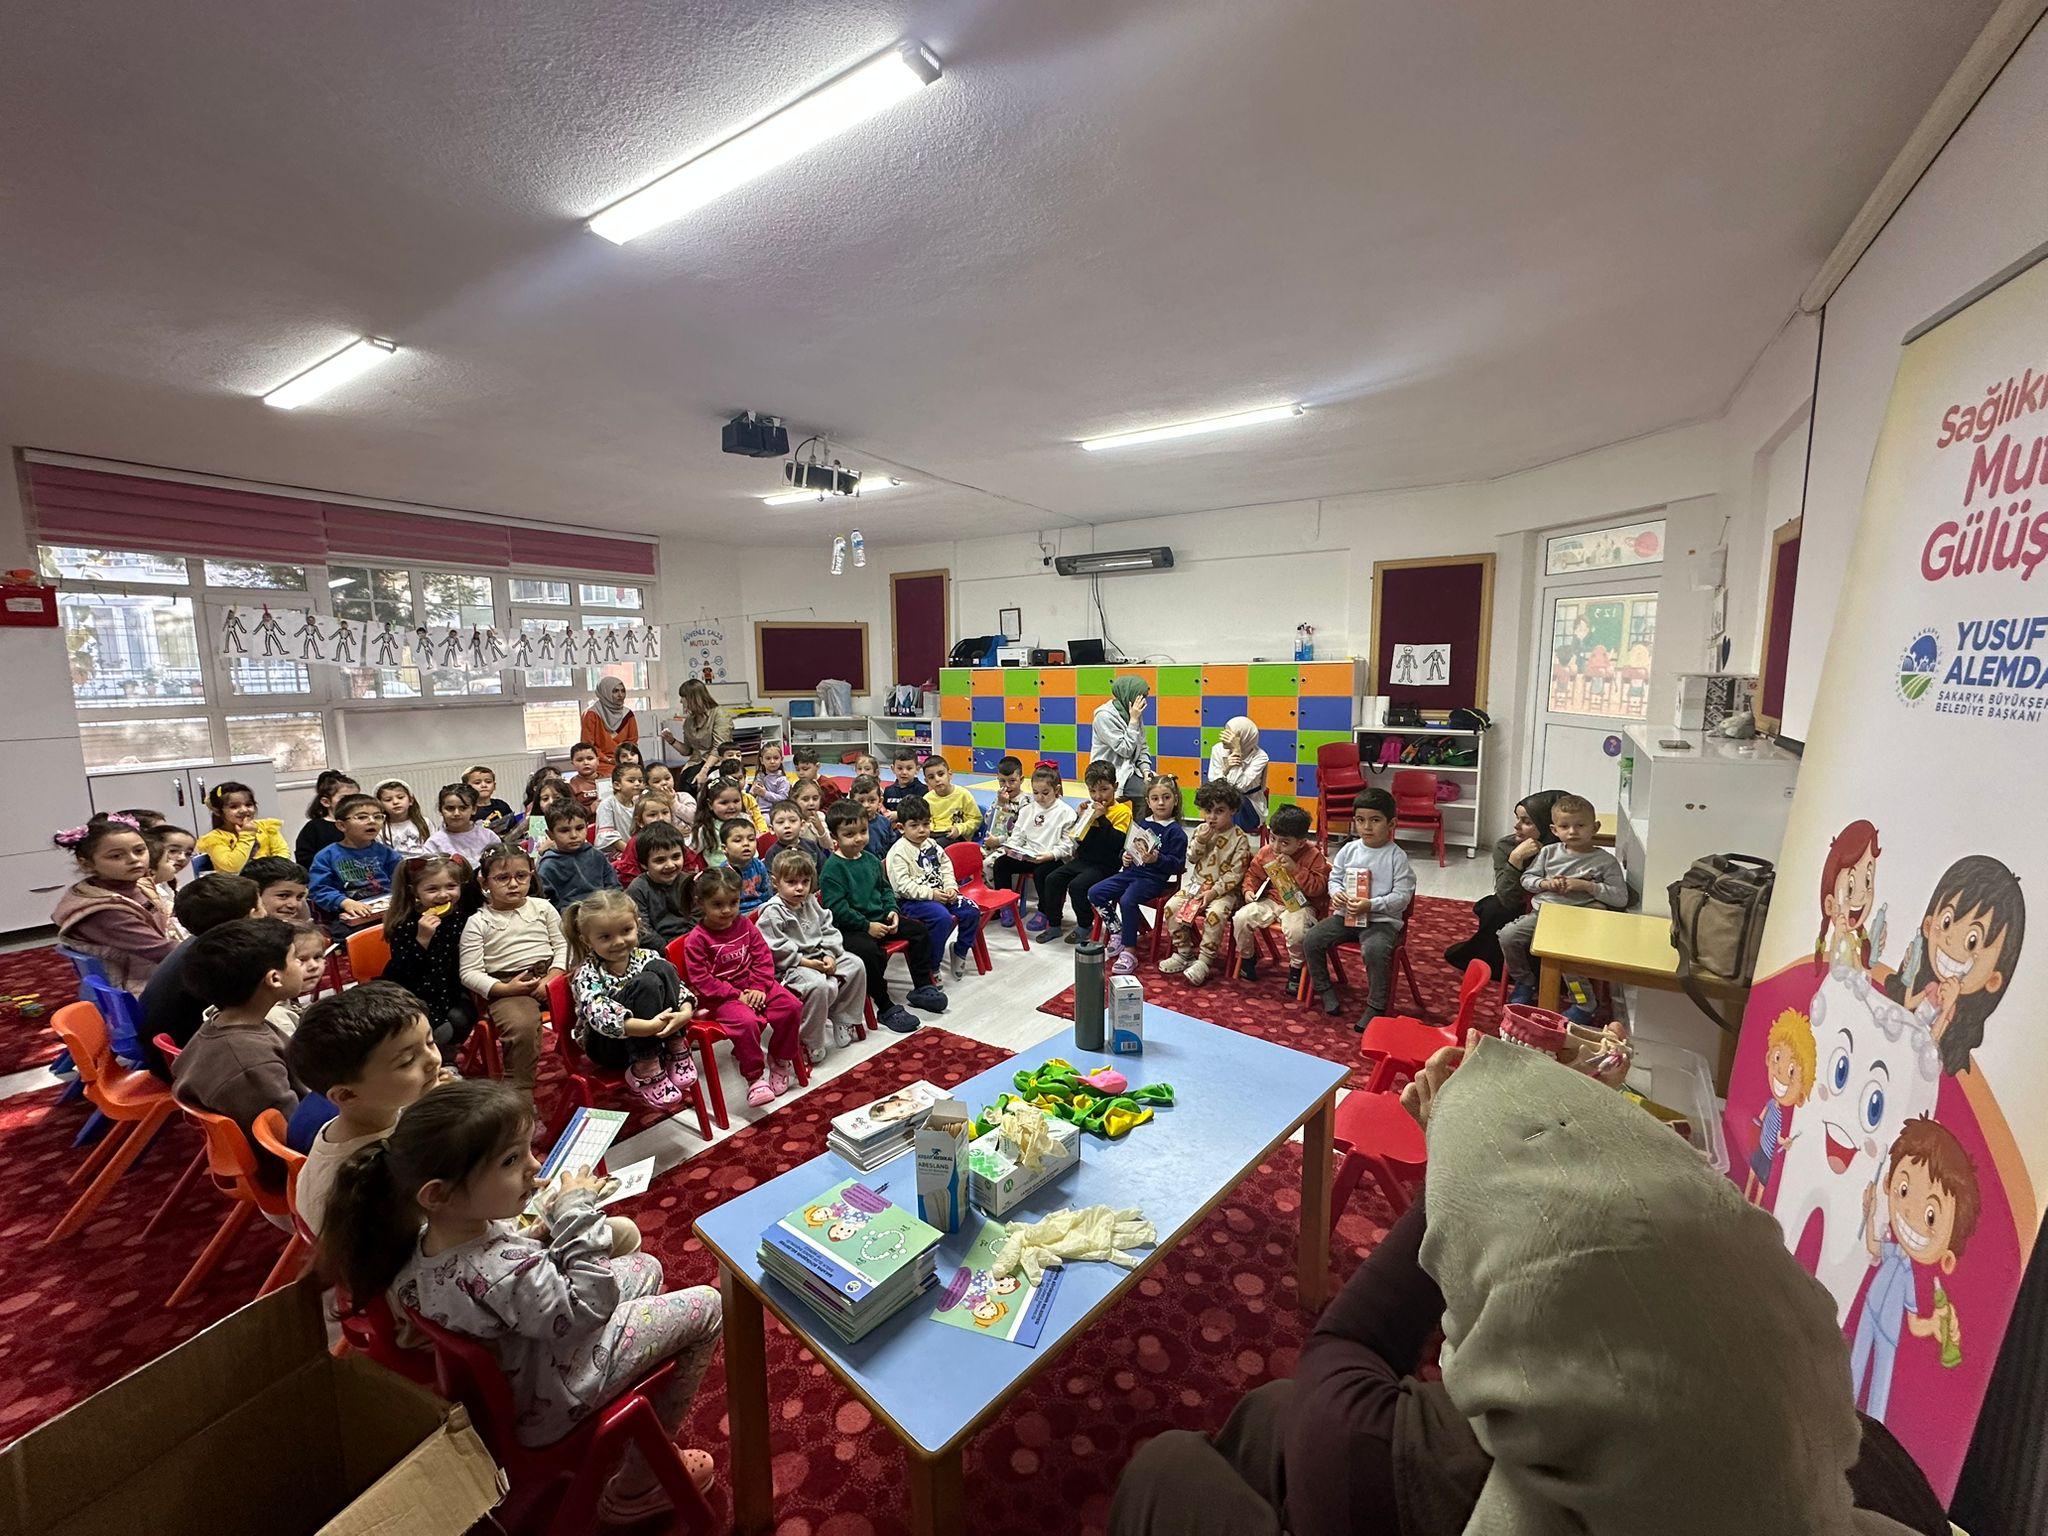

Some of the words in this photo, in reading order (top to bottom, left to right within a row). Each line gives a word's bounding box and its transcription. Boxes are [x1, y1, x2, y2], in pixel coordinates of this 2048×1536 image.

[1957, 617, 2048, 651] YUSUF
[1938, 690, 1984, 704] SAKARYA
[1935, 702, 1984, 717] BELEDİYE
[1987, 706, 2042, 723] BAŞKANI
[918, 1161, 950, 1170] ABESLANG
